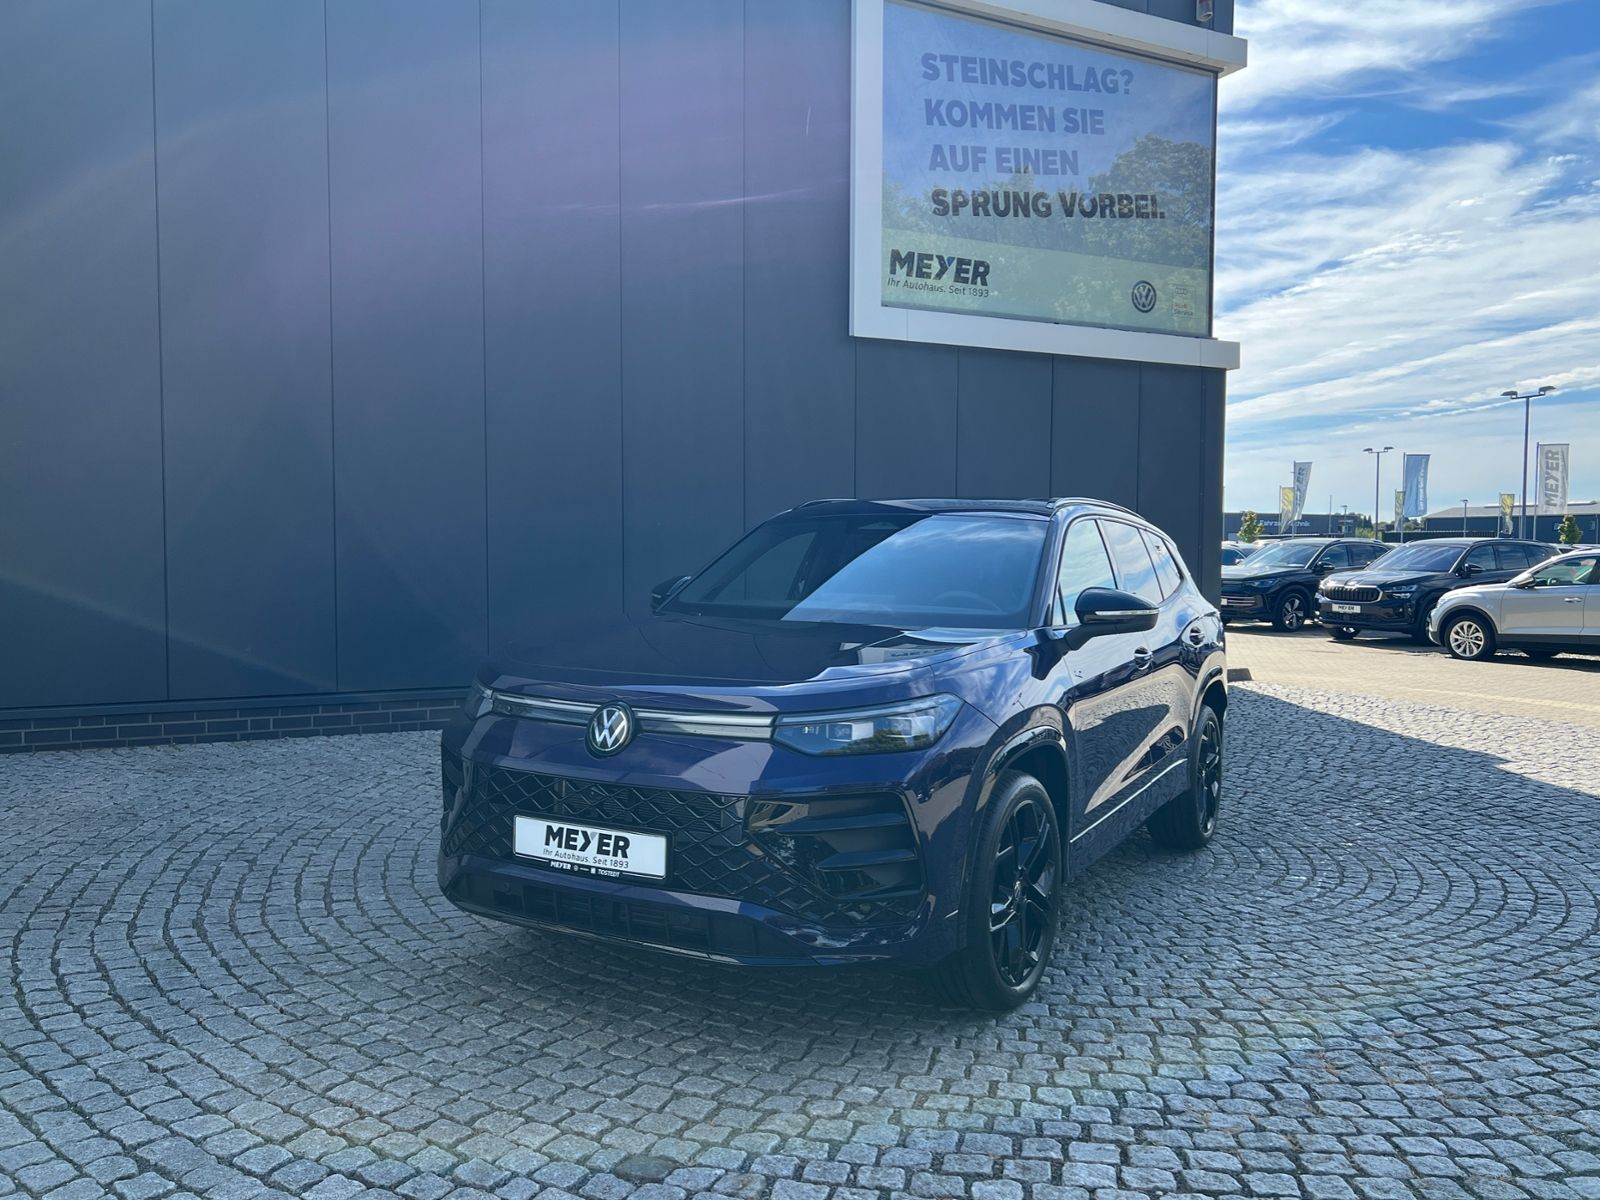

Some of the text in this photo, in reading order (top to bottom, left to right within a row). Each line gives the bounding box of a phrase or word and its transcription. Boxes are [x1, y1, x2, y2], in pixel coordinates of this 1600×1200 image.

[921, 52, 1134, 95] STEINSCHLAG?
[925, 99, 1105, 135] KOMMEN SIE
[929, 144, 1079, 176] AUF EINEN
[932, 188, 1166, 219] SPRUNG VORBEI.
[889, 249, 990, 287] MEYER
[887, 277, 989, 298] Ihr Autohaus. Seit 1893
[1544, 449, 1560, 507] MEYER
[543, 848, 629, 869] Ihr Autohaus. Seit 1893
[544, 825, 630, 859] MEYER
[550, 860, 571, 870] MEYER
